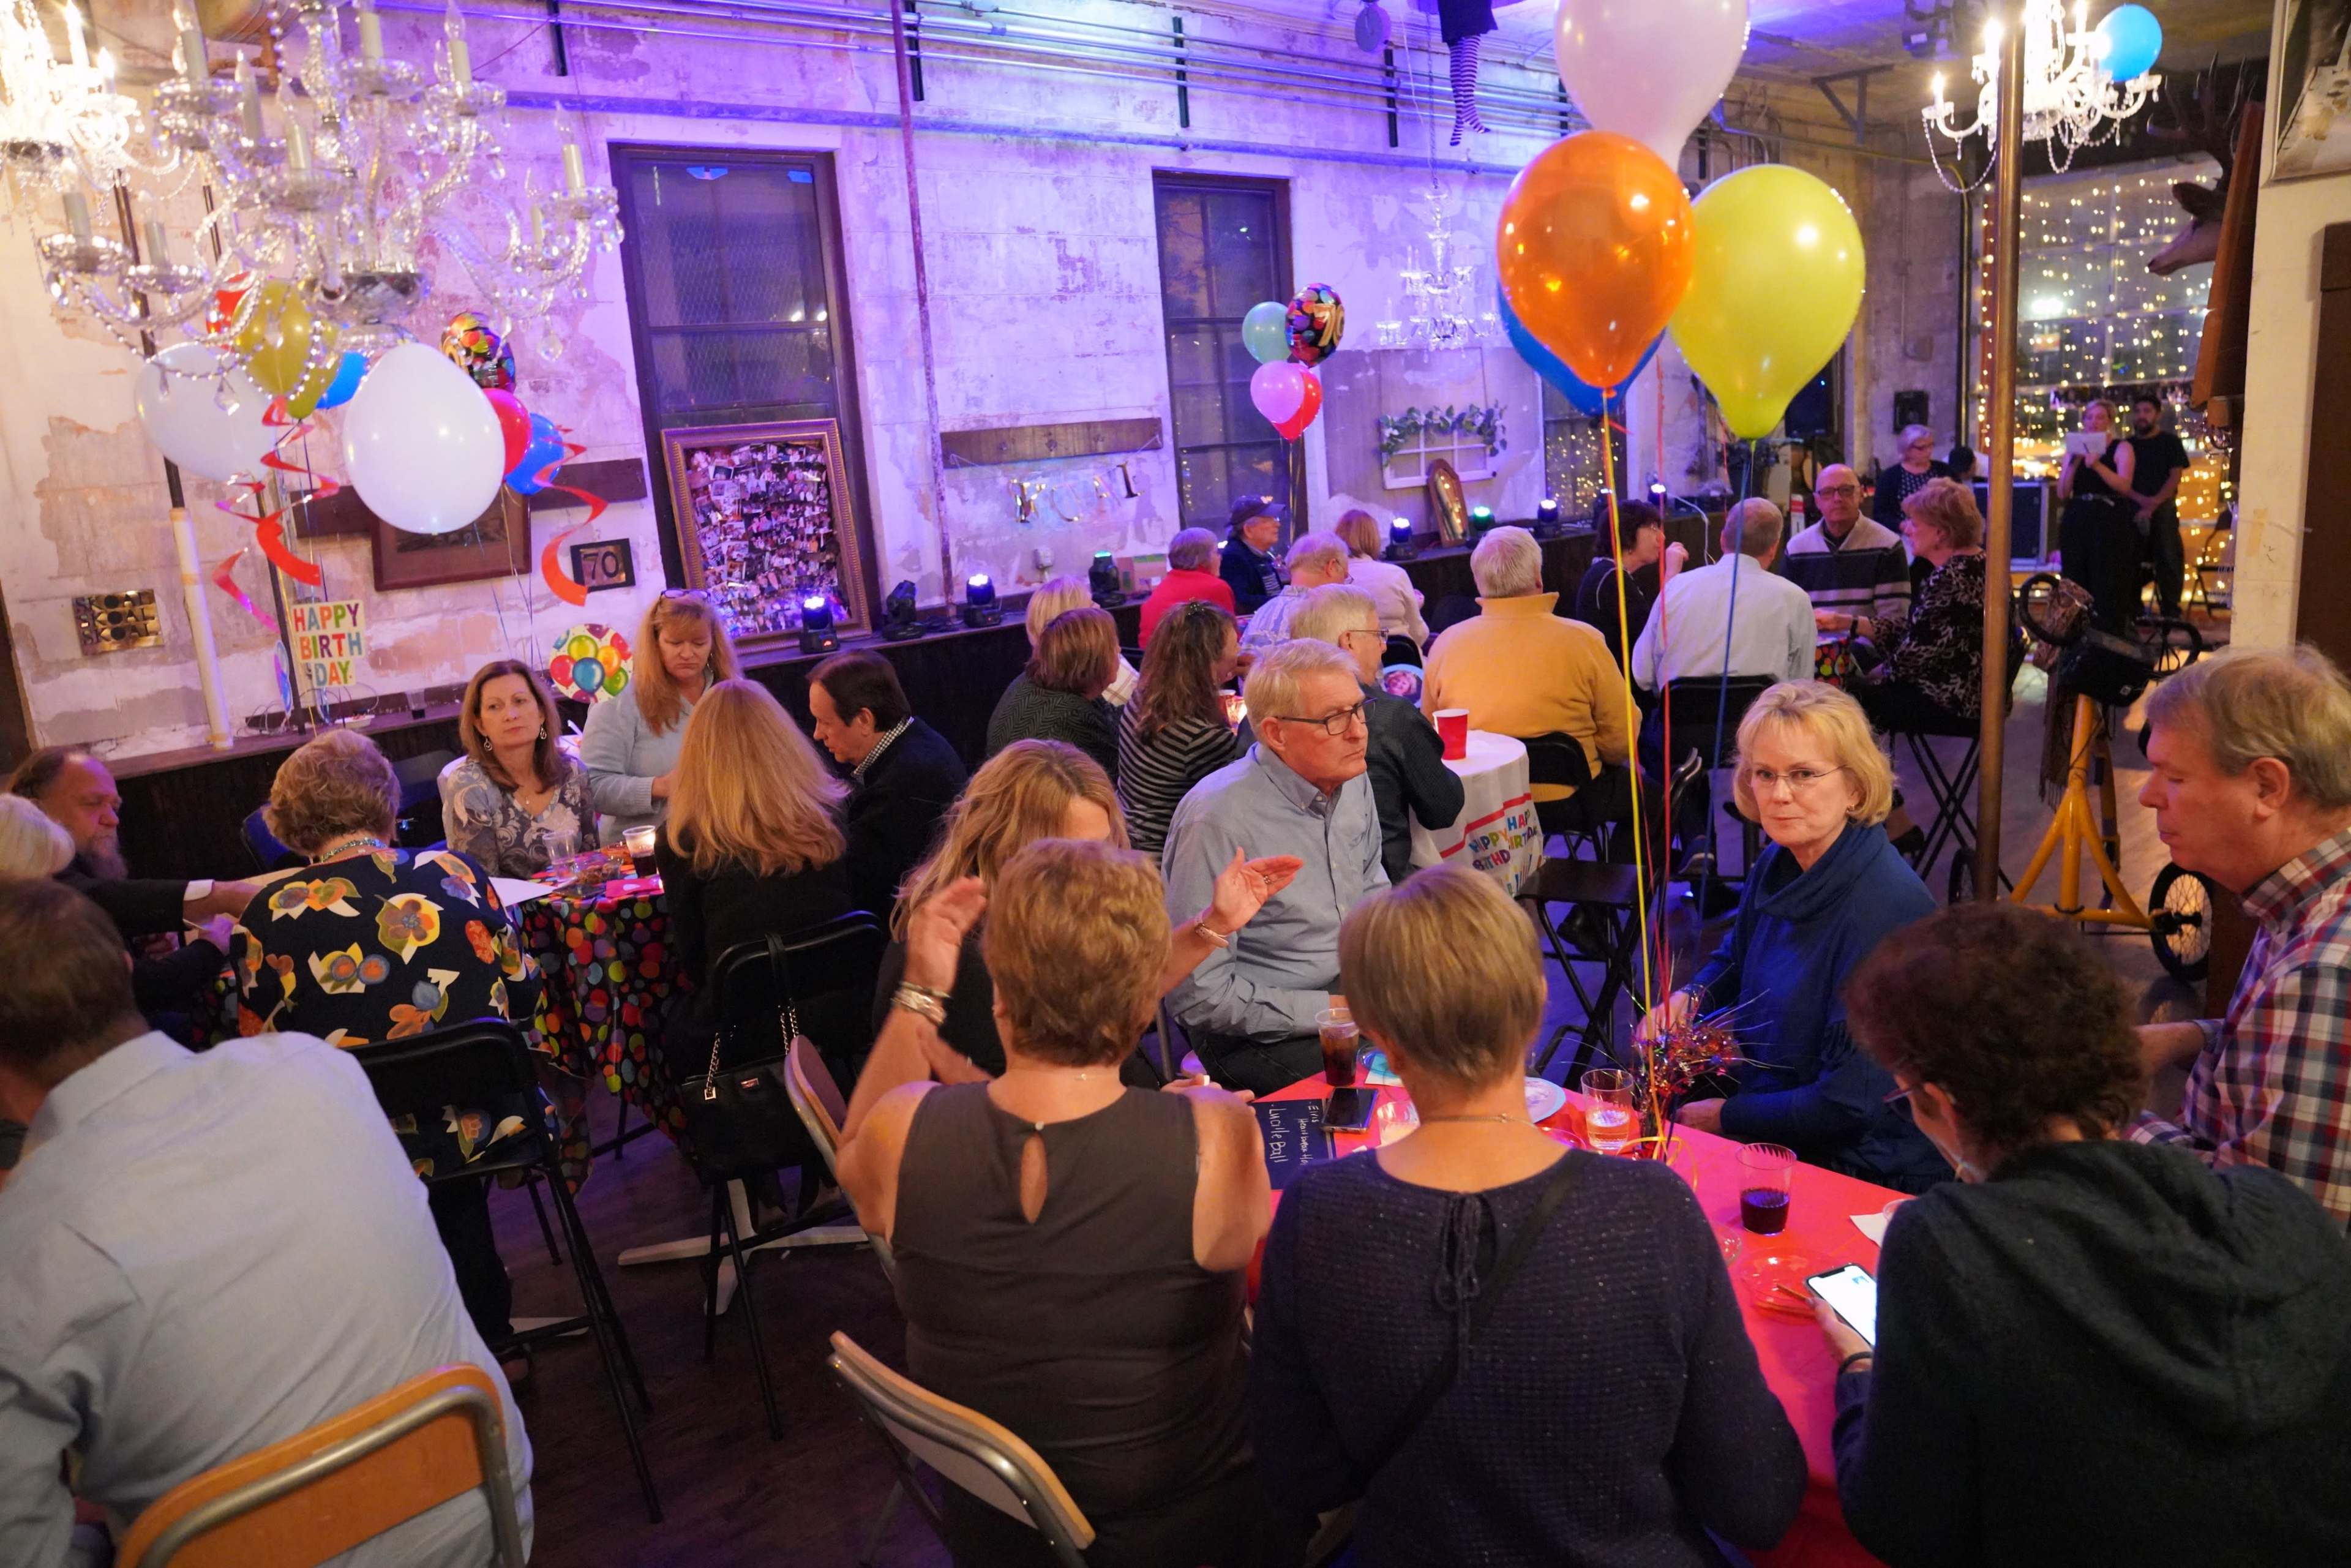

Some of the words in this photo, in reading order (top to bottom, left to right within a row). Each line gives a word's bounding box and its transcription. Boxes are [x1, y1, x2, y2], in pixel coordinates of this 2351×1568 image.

[1312, 302, 1345, 348] 70
[583, 550, 620, 580] 70
[293, 603, 359, 632] HAPPY
[299, 632, 362, 660] BIRTH
[1269, 1141, 1289, 1163] Ball
